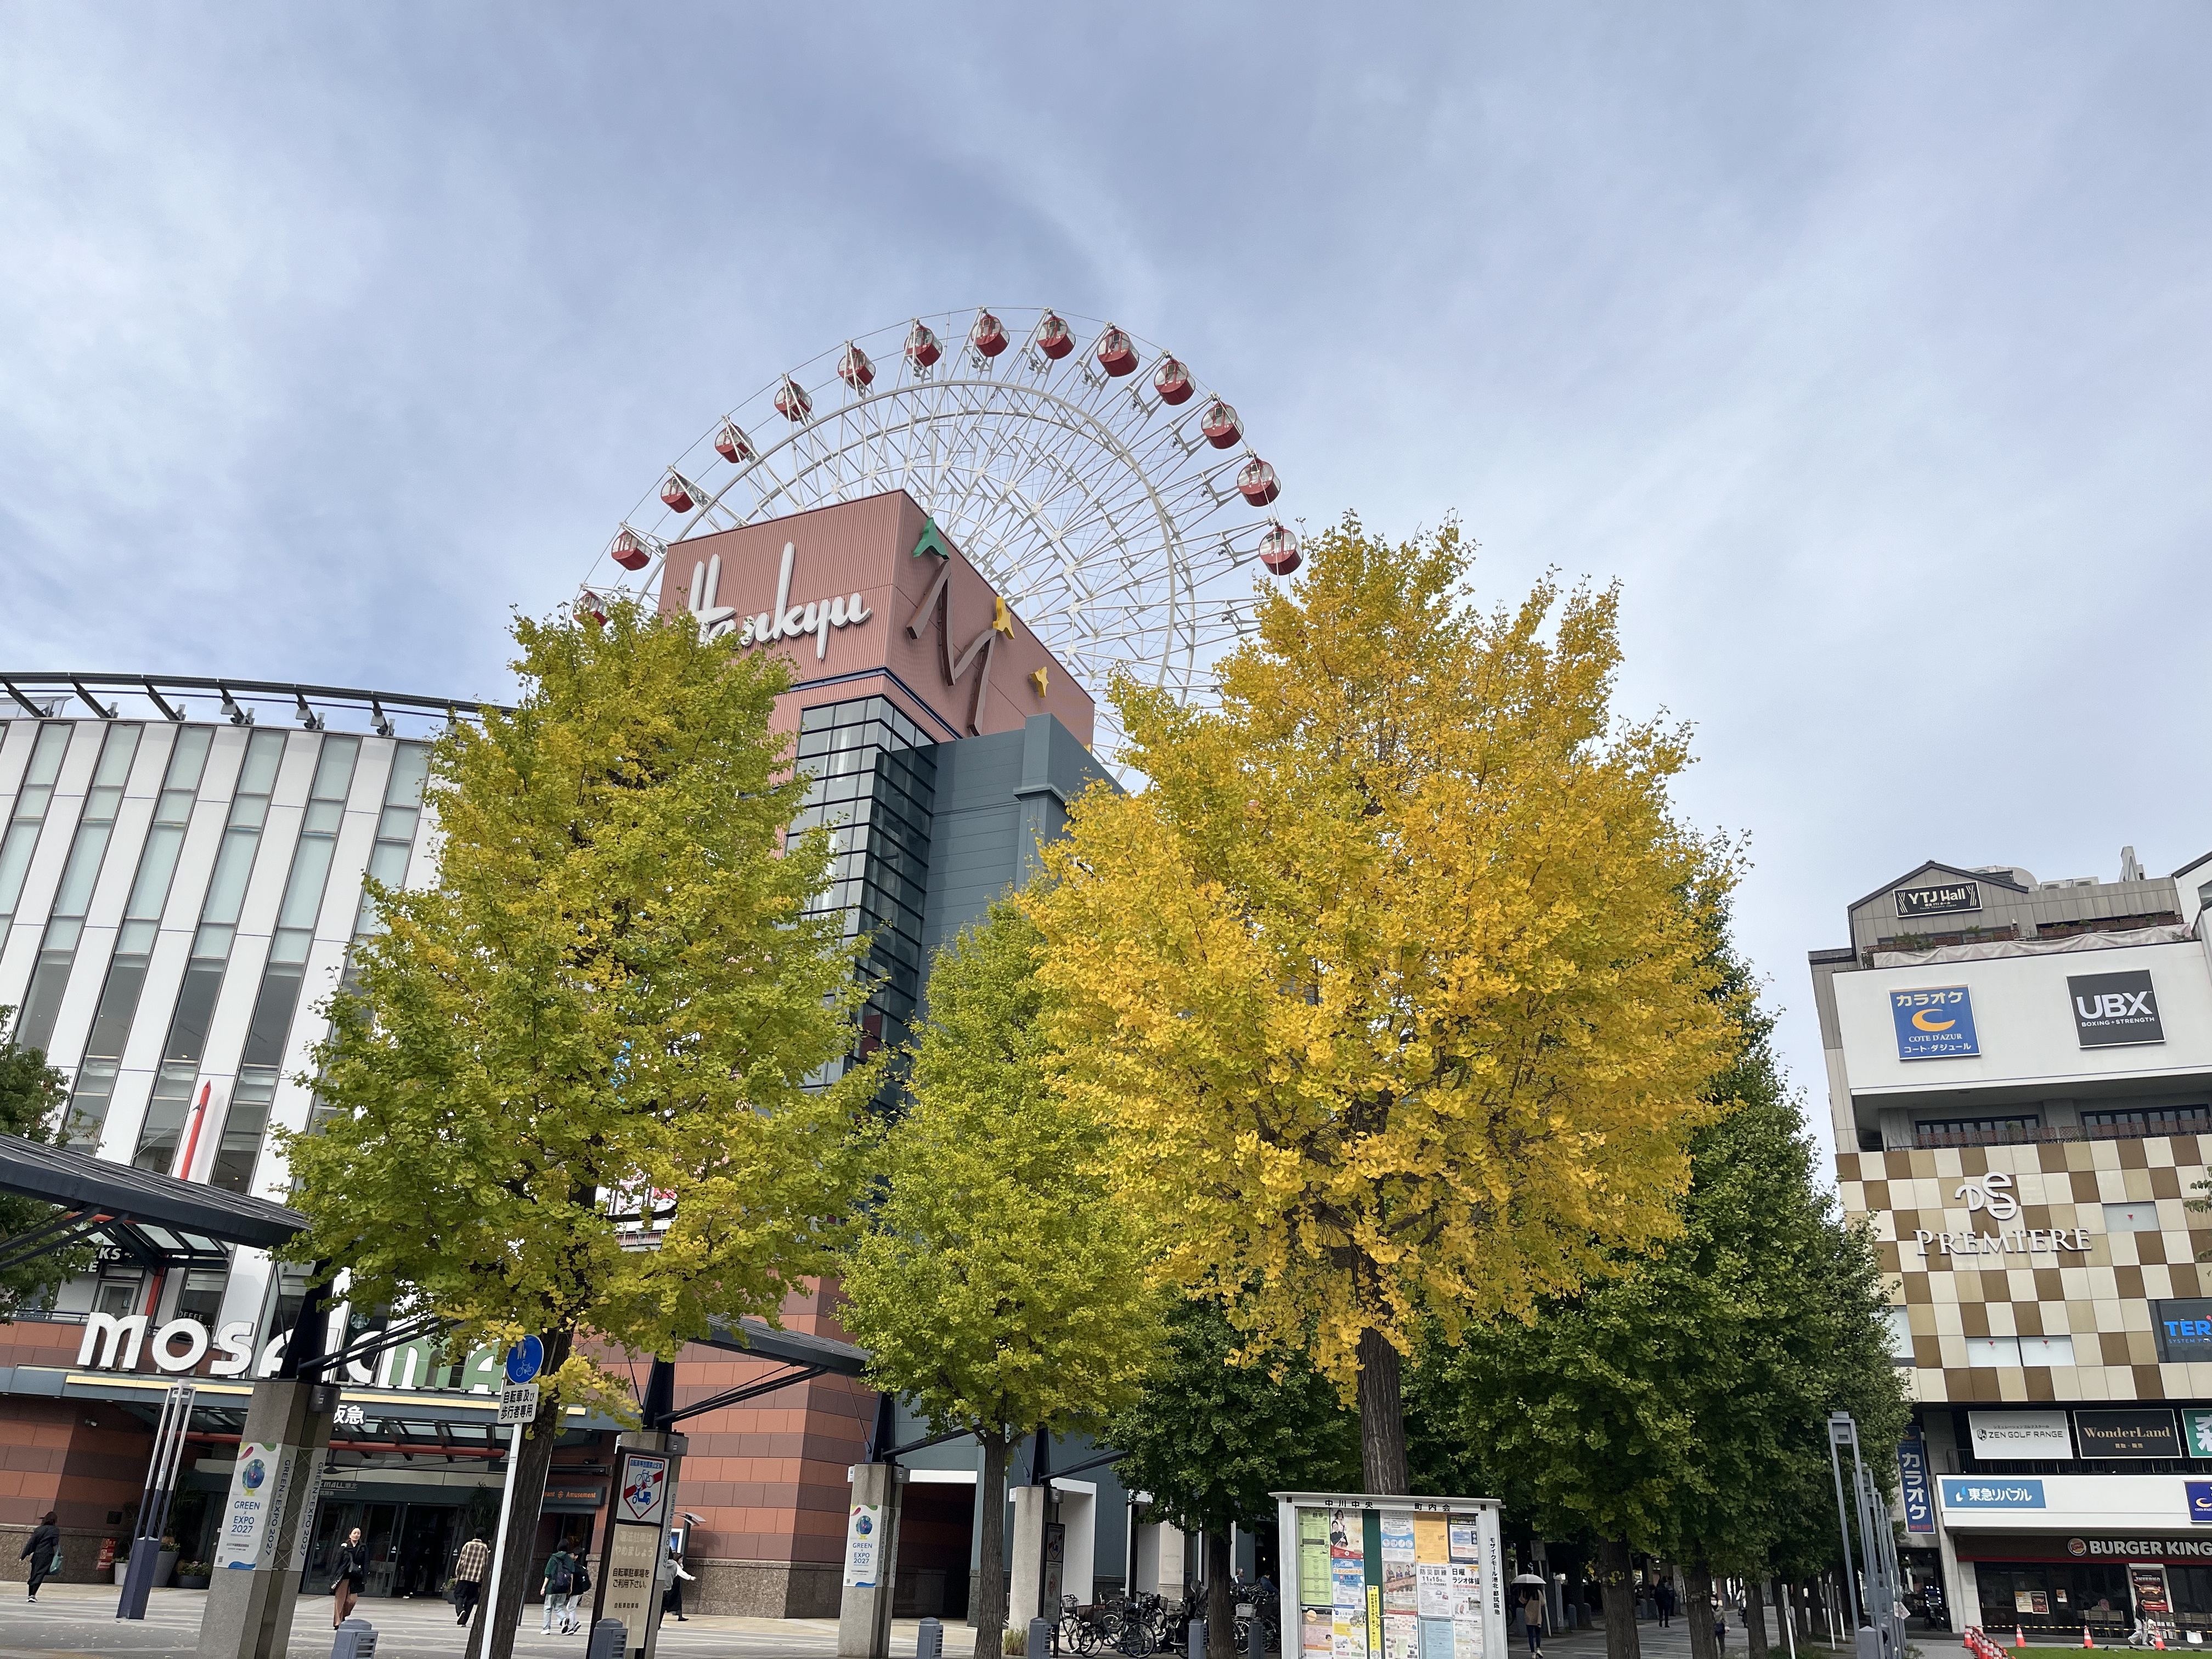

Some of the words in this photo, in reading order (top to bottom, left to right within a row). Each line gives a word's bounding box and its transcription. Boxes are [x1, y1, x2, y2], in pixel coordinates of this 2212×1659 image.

[1908, 891, 1937, 904] YTJ
[1940, 888, 1966, 901] Hall
[1896, 991, 1963, 1007] カラオケ
[2076, 991, 2153, 1019] UBX
[2115, 1017, 2155, 1025] STRENGTH
[1909, 1035, 1931, 1043] COTE
[1904, 1042, 1972, 1054] コート・ダジュール
[1912, 1227, 2092, 1256] PREMIERE
[503, 1389, 535, 1403] 自転車及び
[500, 1404, 533, 1419] 歩行者専用
[2083, 1426, 2171, 1438] WonderLand
[278, 1459, 291, 1492] GREEN
[312, 1462, 324, 1494] GREEN
[1901, 1452, 1927, 1520] カラオケ
[1967, 1487, 2032, 1502] 東急リバブル
[234, 1501, 261, 1510] GREEN
[272, 1499, 283, 1526] EXPO
[1325, 1499, 1374, 1509] 中川中央
[1414, 1503, 1451, 1512] 町内会
[234, 1516, 255, 1525] EXPO
[306, 1502, 315, 1527] EXPO
[231, 1525, 253, 1533] 2027
[266, 1529, 276, 1556] 2027
[300, 1530, 309, 1556] 2027
[2089, 1541, 2163, 1555] BURGER
[2166, 1541, 2212, 1556] KING
[615, 1545, 653, 1558] やめましょう
[612, 1567, 650, 1578] 自転車駐車場を
[613, 1579, 647, 1589] ご利用下さい。
[1452, 1577, 1480, 1585] ラジオ体操
